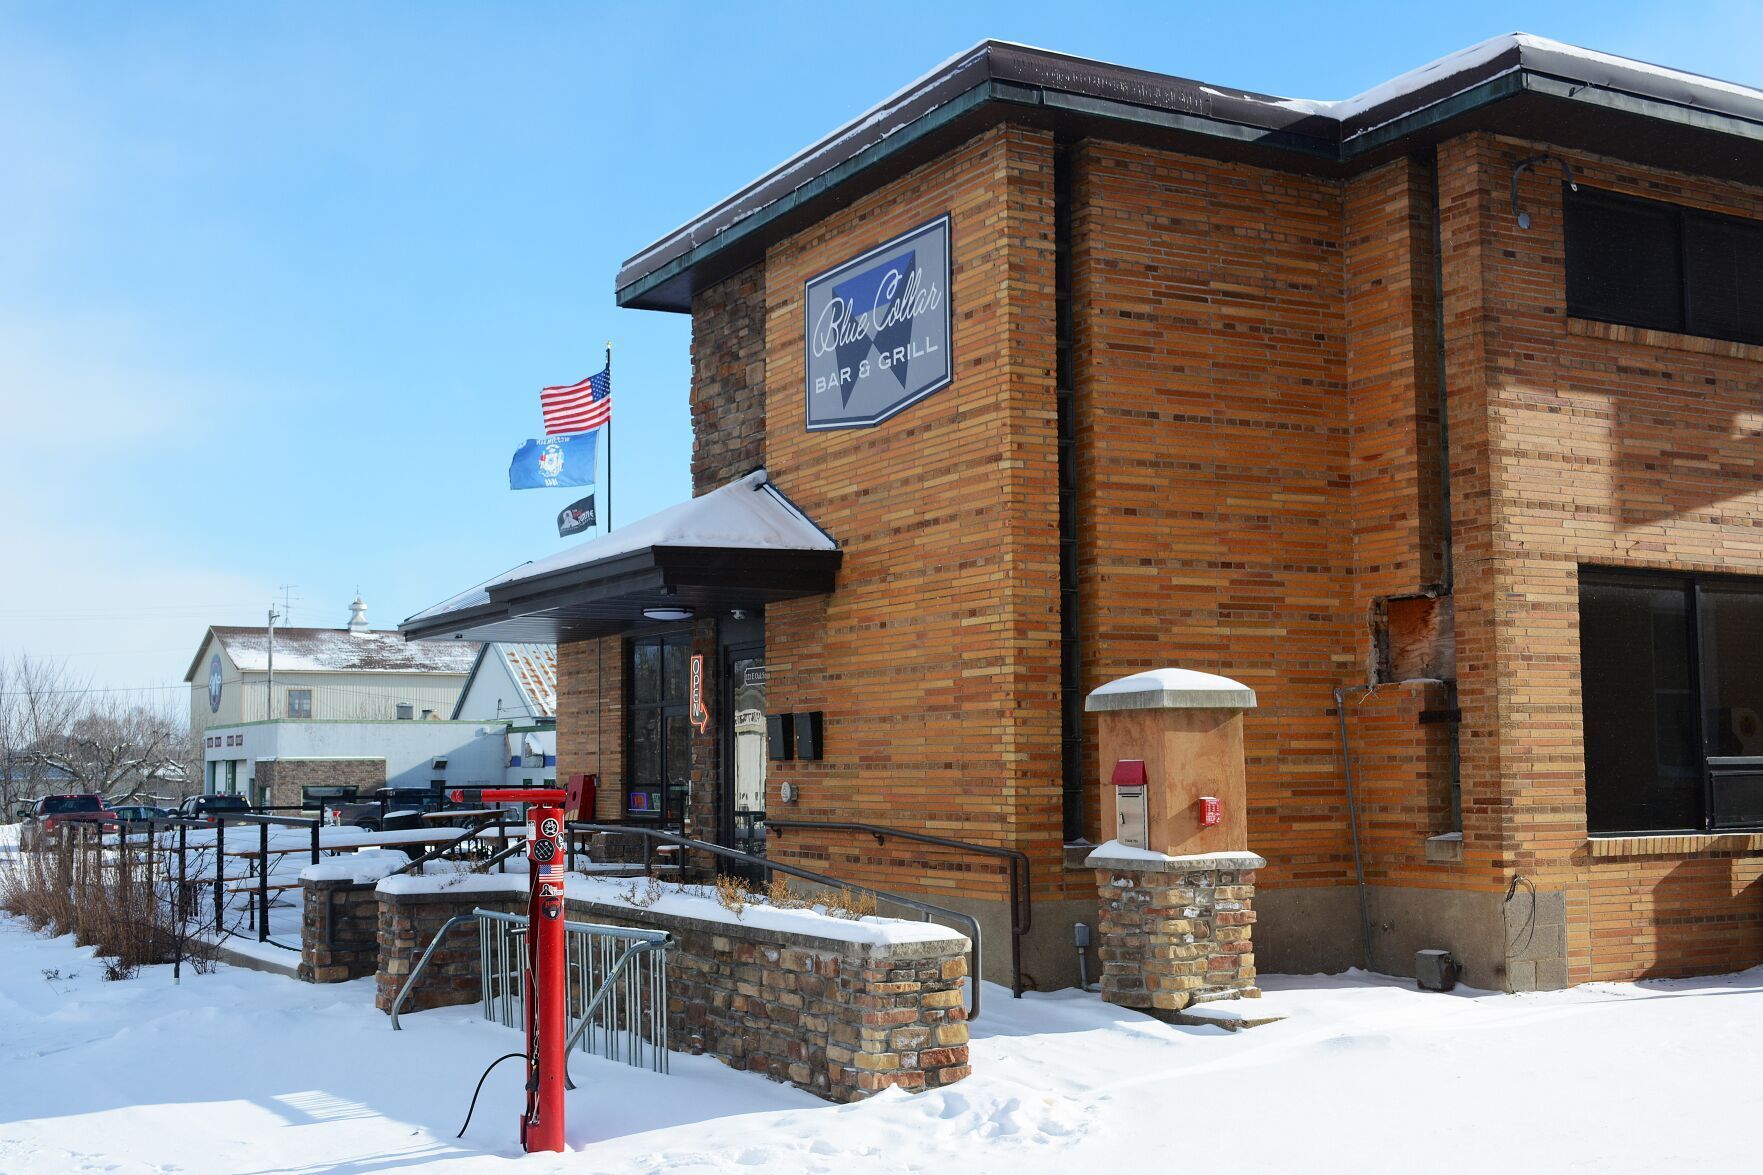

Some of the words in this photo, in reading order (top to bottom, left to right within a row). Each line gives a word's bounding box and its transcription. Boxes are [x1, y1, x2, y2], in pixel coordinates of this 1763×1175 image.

[813, 297, 870, 357] Blue
[873, 268, 942, 332] Collar
[815, 367, 851, 394] BAR
[859, 360, 870, 378] &
[878, 336, 938, 370] GRILL
[692, 659, 700, 717] OPEN
